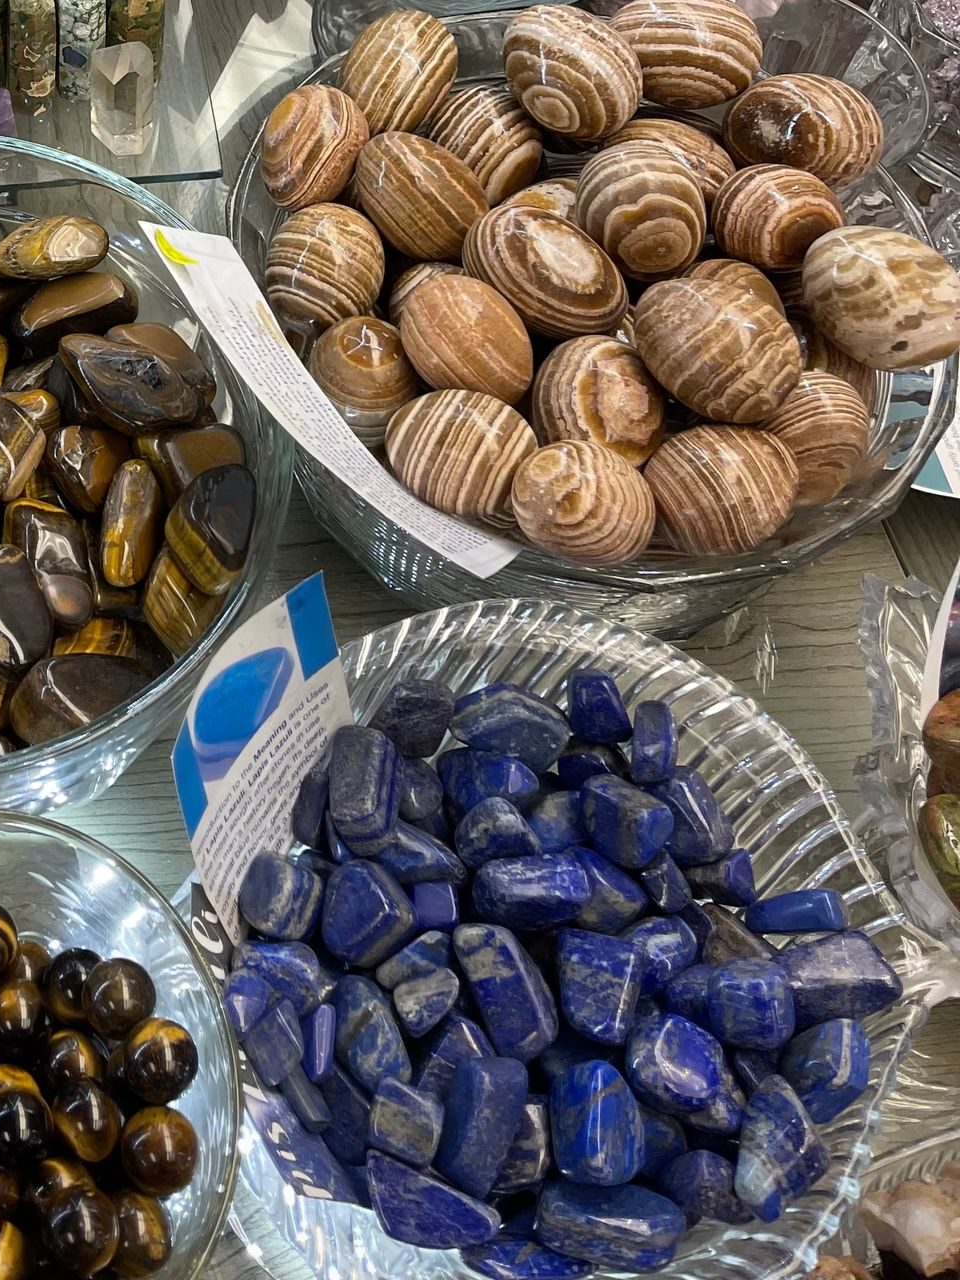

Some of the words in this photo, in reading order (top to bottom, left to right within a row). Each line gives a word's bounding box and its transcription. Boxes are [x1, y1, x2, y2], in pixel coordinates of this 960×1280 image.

[200, 853, 208, 869] of
[205, 824, 224, 855] Lapis
[247, 759, 269, 788] Lapis
[269, 728, 293, 759] Lazuli
[293, 720, 302, 730] is
[302, 703, 320, 721] one
[320, 692, 331, 706] of
[203, 861, 213, 880] the
[212, 831, 229, 860] most
[229, 796, 253, 832] sought
[253, 772, 270, 798] after
[270, 742, 296, 773] stones
[295, 732, 304, 744] in
[304, 716, 321, 734] use
[208, 862, 223, 892] since
[222, 829, 243, 861] man's
[242, 795, 267, 829] history
[292, 748, 303, 763] Its
[303, 726, 327, 750] deep,
[214, 859, 236, 904] celestial
[234, 835, 251, 859] blue
[250, 796, 278, 837] remains
[277, 779, 290, 796] the
[290, 745, 319, 780] symbol
[319, 735, 329, 748] of
[232, 779, 241, 793] to
[240, 763, 253, 780] the
[253, 719, 288, 763] Meaning
[288, 701, 305, 721] and
[305, 682, 329, 704] Uses
[221, 879, 237, 917] royalty
[235, 858, 248, 880] and
[247, 827, 270, 857] honor,
[269, 799, 288, 826] gods
